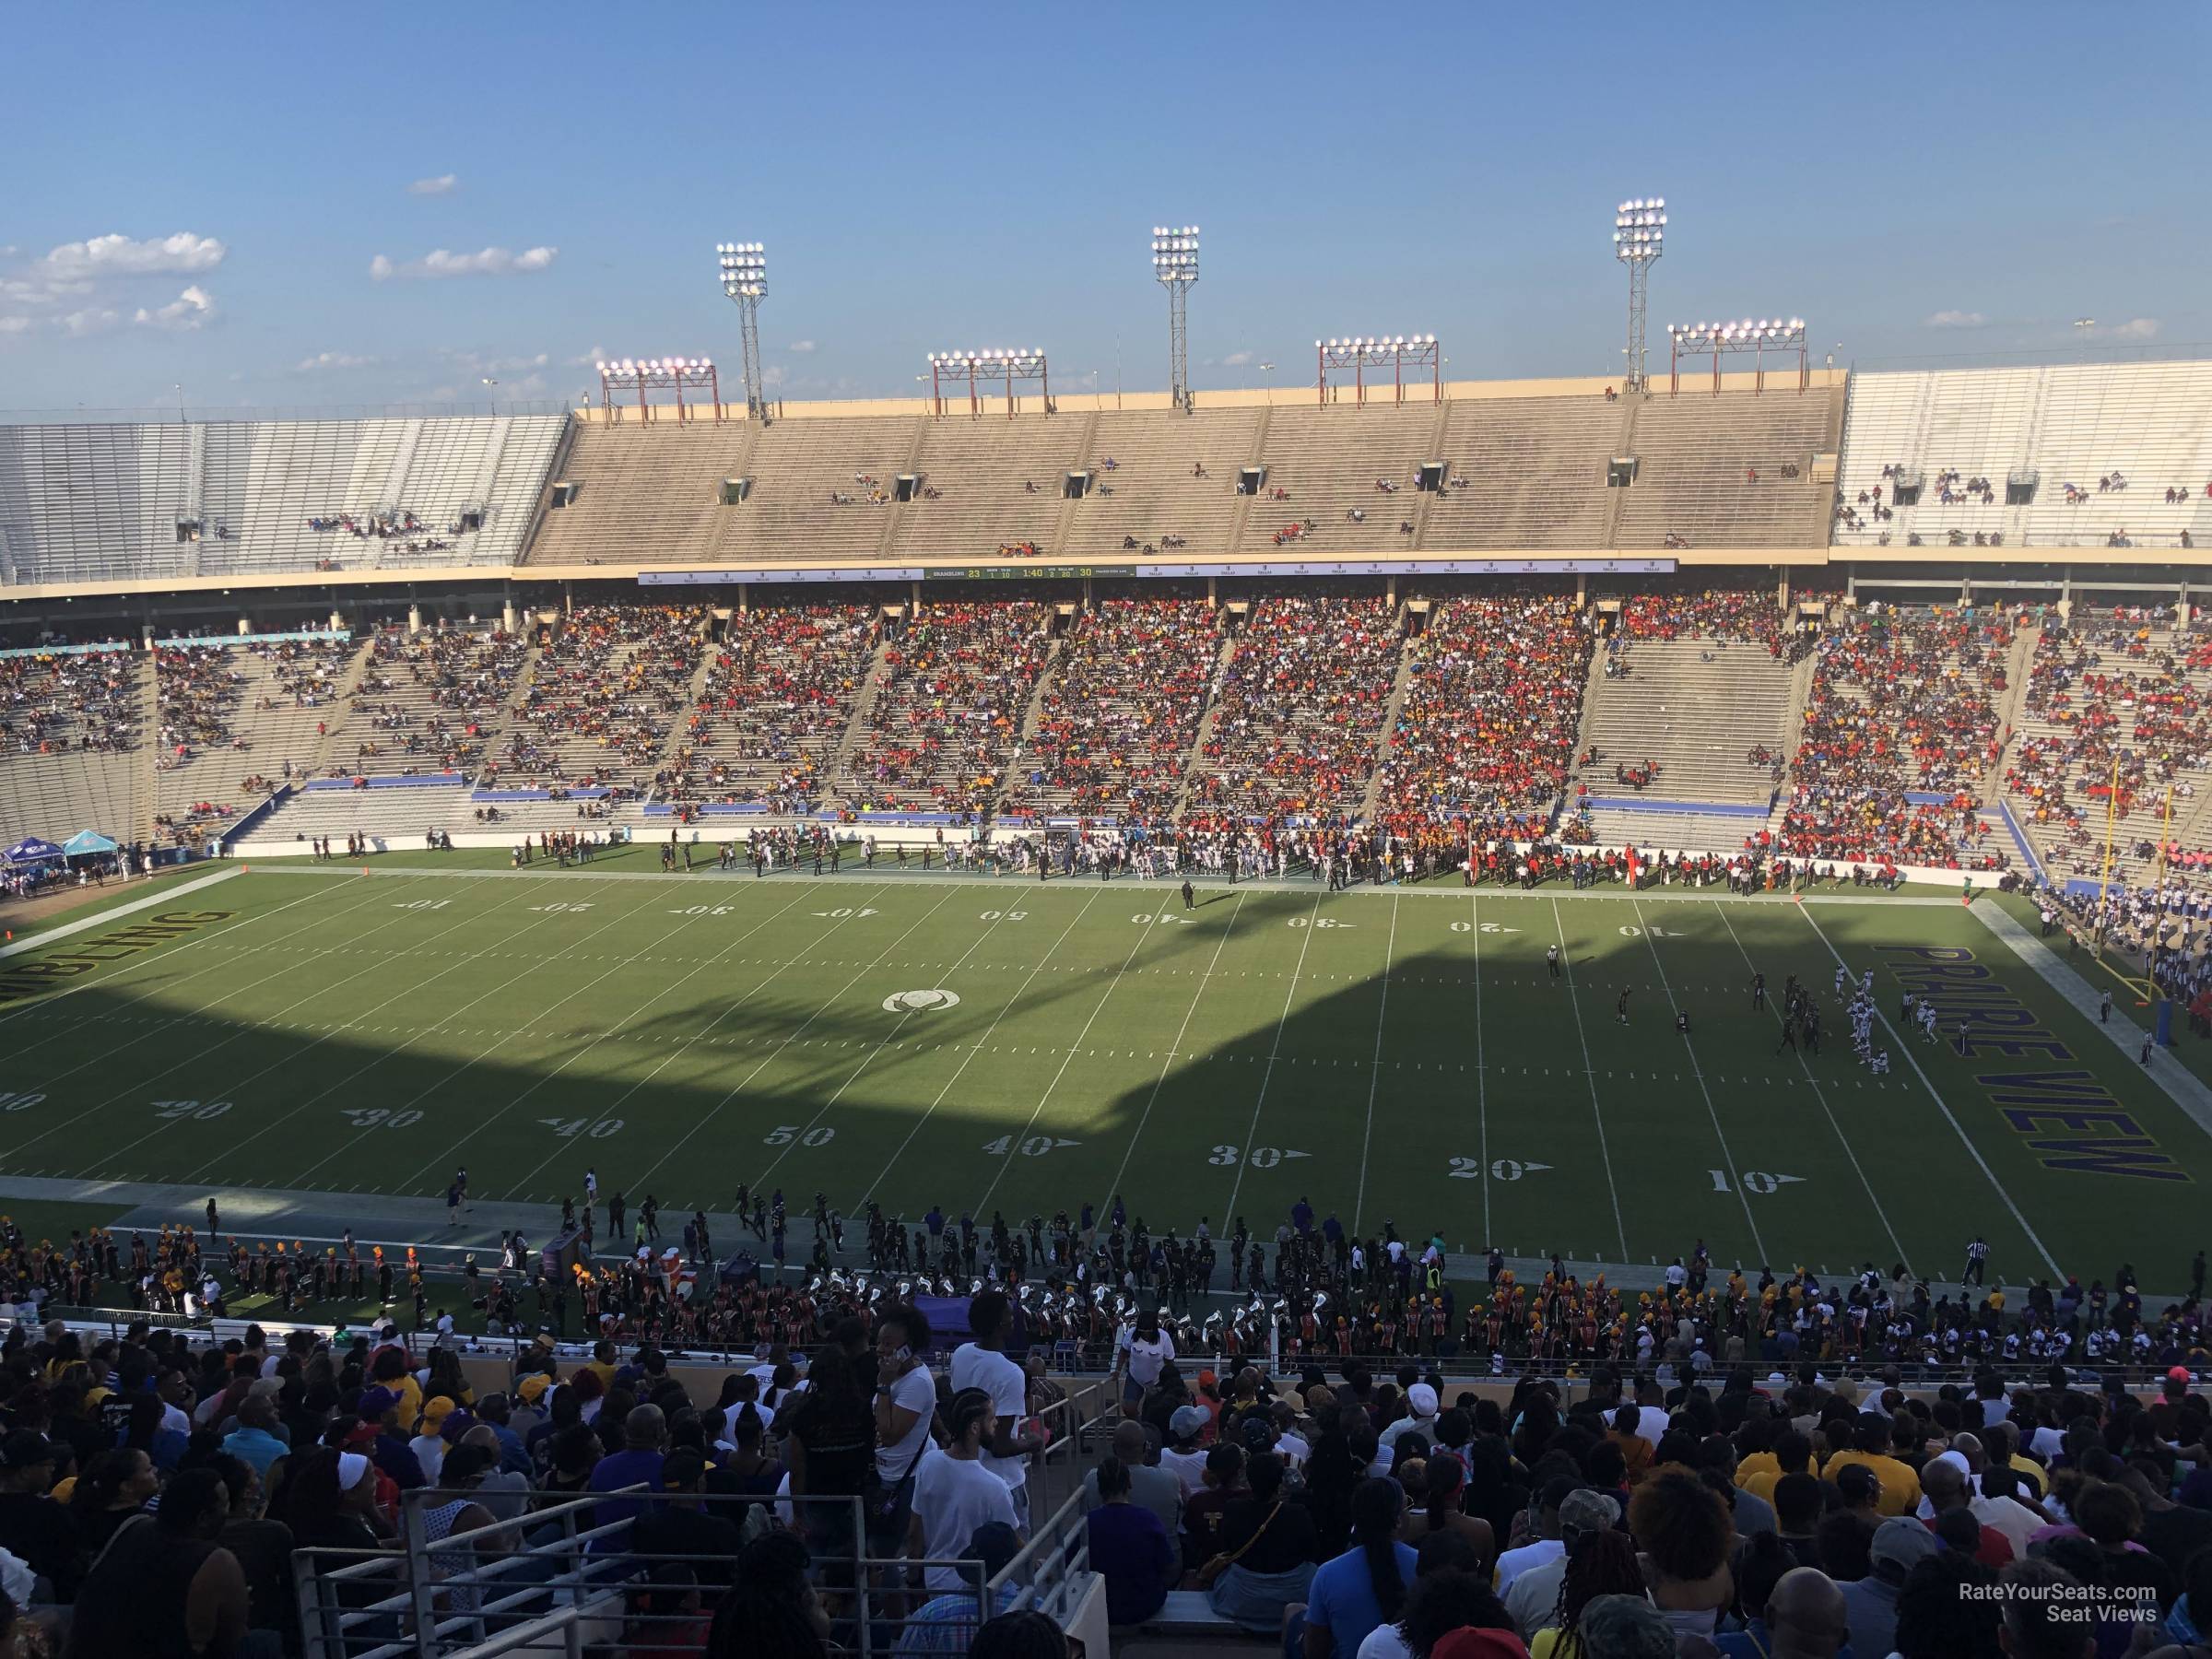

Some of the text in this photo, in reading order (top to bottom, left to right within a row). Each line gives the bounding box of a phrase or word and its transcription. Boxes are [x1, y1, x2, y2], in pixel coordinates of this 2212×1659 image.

[968, 570, 981, 578] 23
[1023, 569, 1043, 577] 1:40
[1079, 568, 1092, 577] 30
[406, 900, 453, 909] 10
[544, 902, 595, 912] 20
[685, 905, 735, 915] 30
[830, 908, 878, 918] 40
[980, 911, 1029, 921] 50
[1131, 913, 1180, 924] 40
[1288, 917, 1337, 928] 30
[1450, 922, 1500, 933] 20
[1618, 925, 1666, 937] 10
[1872, 947, 2194, 1182] PRAIRIE VIEW
[155, 1100, 232, 1119] 20
[352, 1108, 424, 1128] 30
[554, 1118, 624, 1137] 40
[763, 1126, 835, 1147] 50
[982, 1135, 1053, 1156] 40
[1208, 1145, 1280, 1168] 30
[1448, 1158, 1523, 1181] 20
[1708, 1170, 1777, 1194] 10
